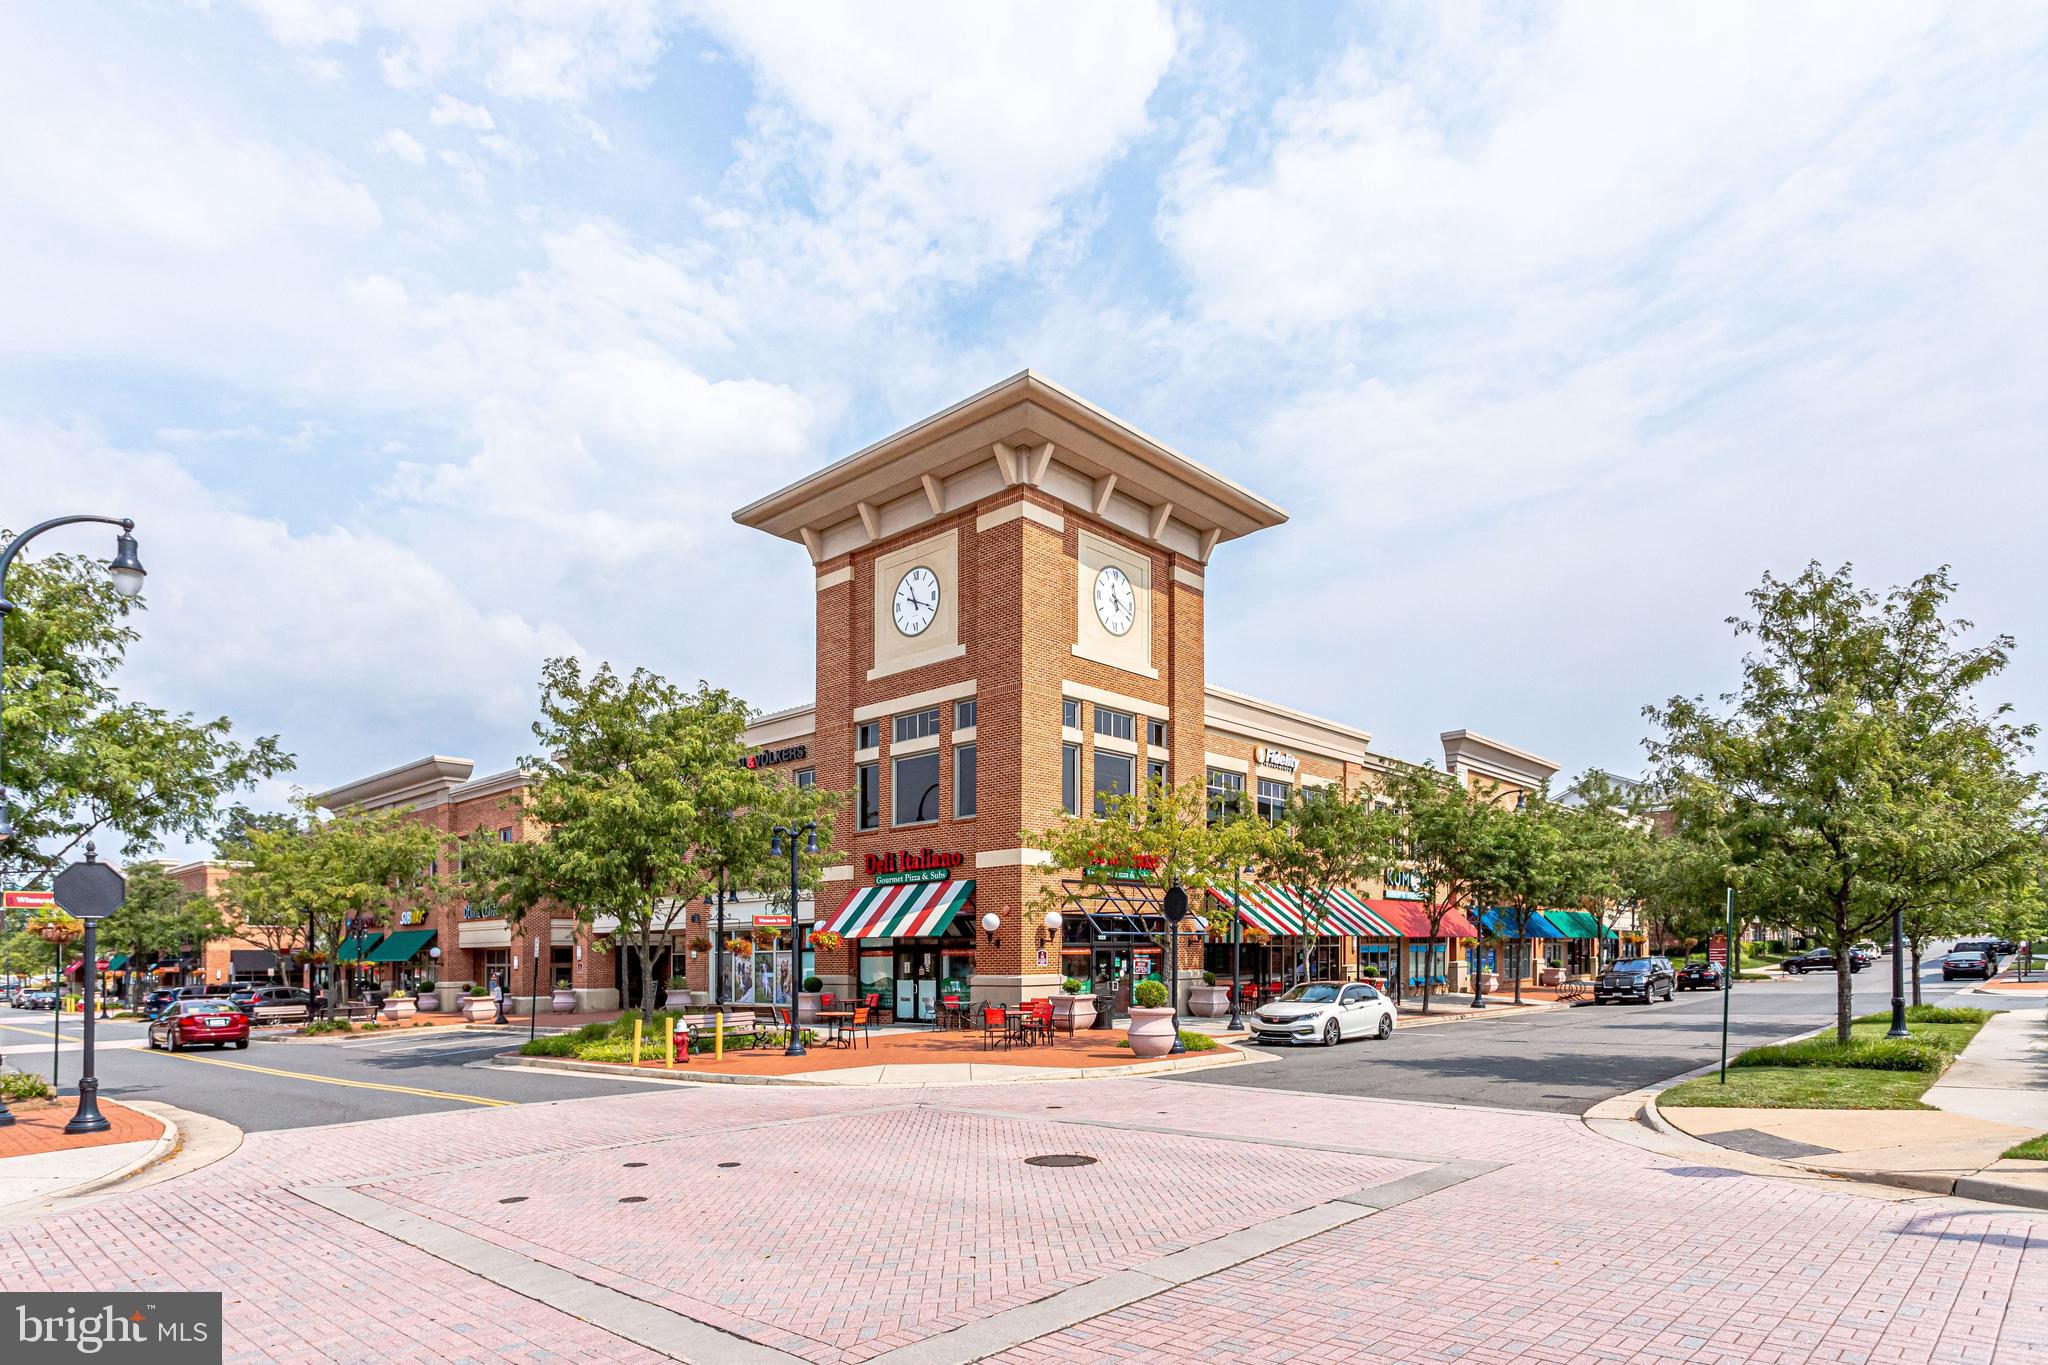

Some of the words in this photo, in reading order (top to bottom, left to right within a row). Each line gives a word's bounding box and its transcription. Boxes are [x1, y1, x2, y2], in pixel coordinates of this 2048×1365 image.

[746, 755, 757, 769] &
[1266, 749, 1300, 770] Fidelity
[863, 852, 896, 875] Deli
[899, 847, 963, 871] Italiano
[876, 874, 904, 885] Gourmet
[904, 873, 921, 882] Pizza
[921, 872, 929, 880] &
[930, 869, 946, 880] Subs
[400, 910, 425, 925] SUBWAY
